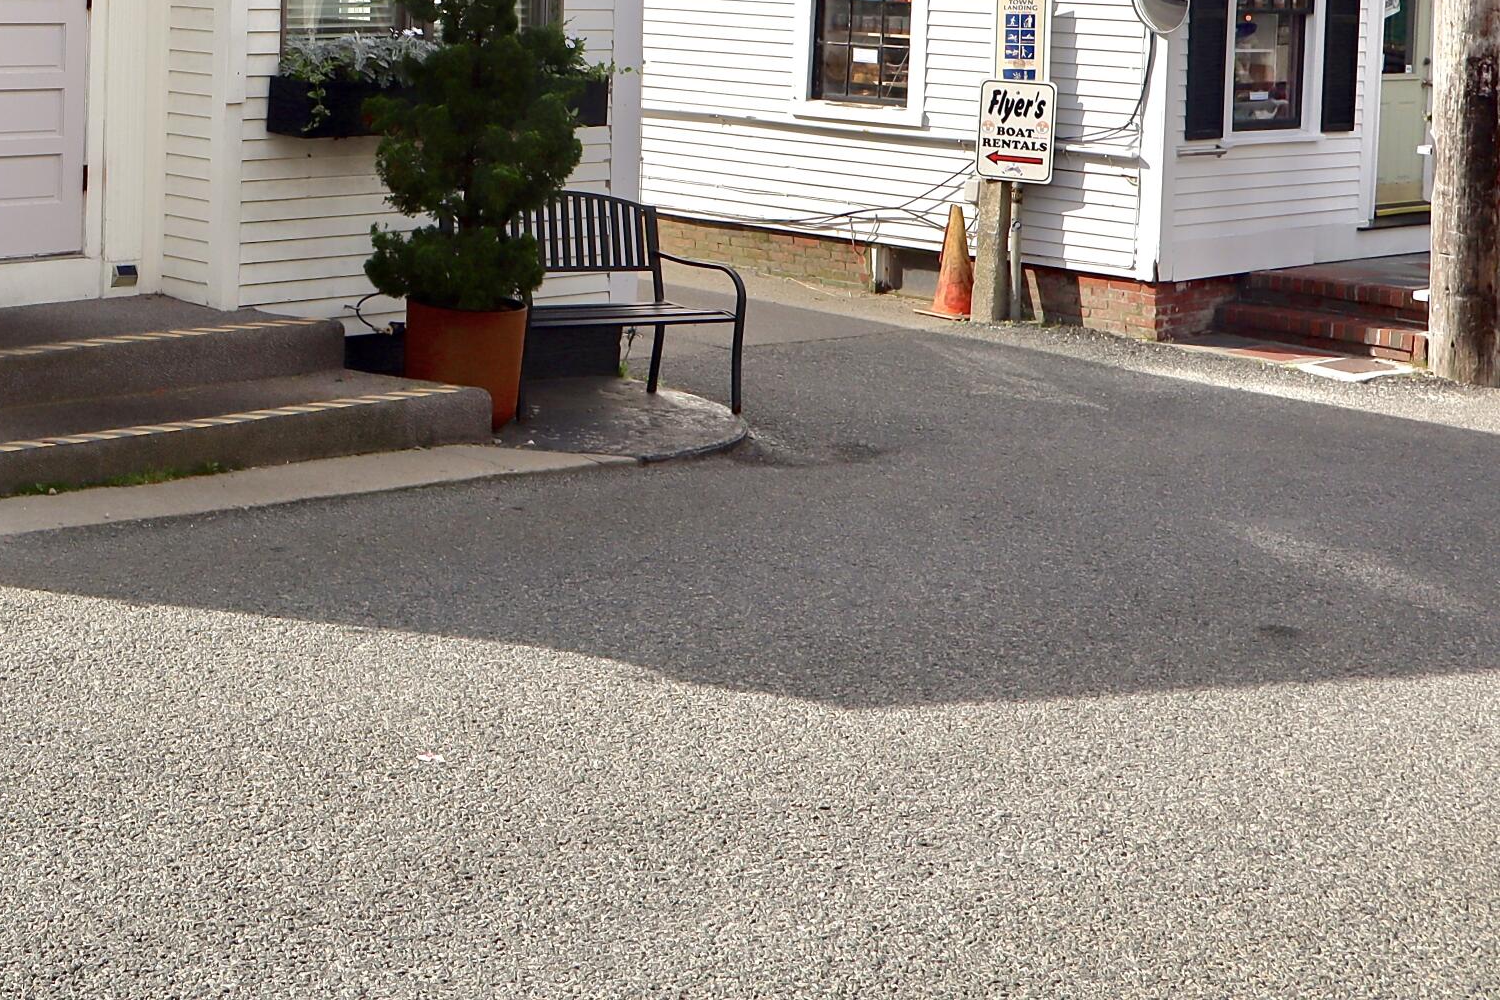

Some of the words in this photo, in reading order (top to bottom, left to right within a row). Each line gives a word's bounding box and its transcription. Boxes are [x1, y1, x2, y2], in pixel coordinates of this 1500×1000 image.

[988, 89, 1047, 124] Flyer's
[997, 126, 1035, 138] BOAT
[982, 137, 1048, 152] RENTALS
